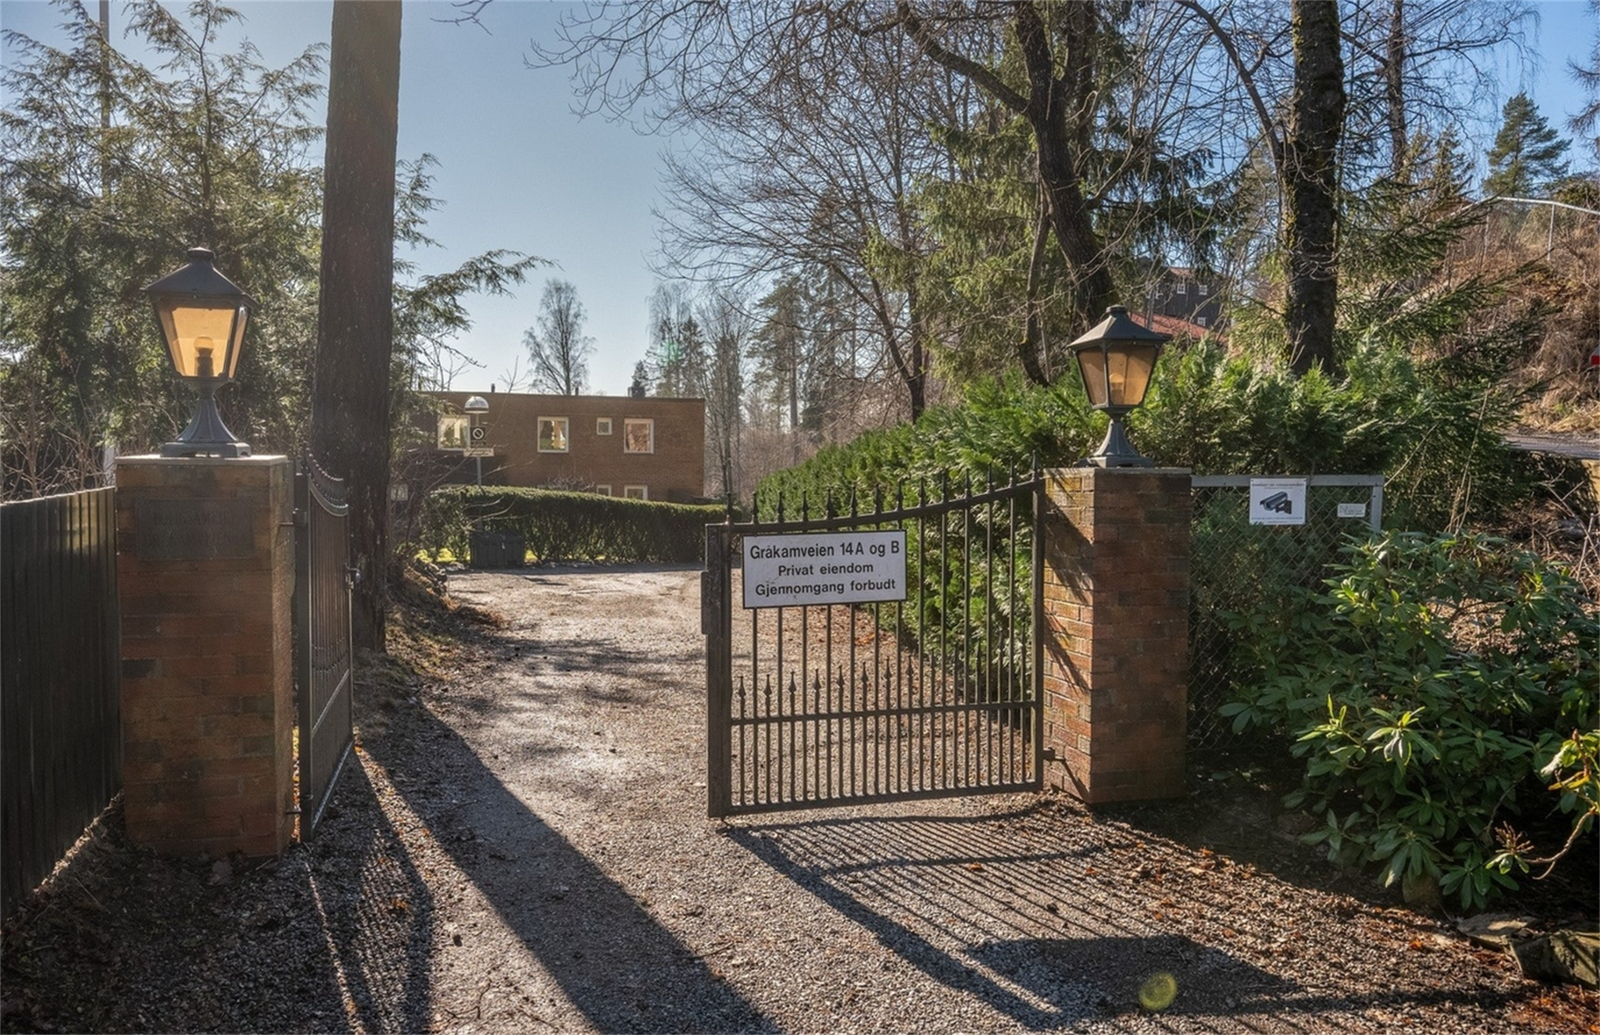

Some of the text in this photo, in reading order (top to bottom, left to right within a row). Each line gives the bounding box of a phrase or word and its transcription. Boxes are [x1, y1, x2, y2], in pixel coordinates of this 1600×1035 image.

[750, 543, 834, 559] Gråkamveien
[869, 544, 885, 557] og
[891, 540, 899, 553] B
[778, 562, 873, 576] Privat eiendom
[755, 579, 895, 597] Gjennomgang forbudt
